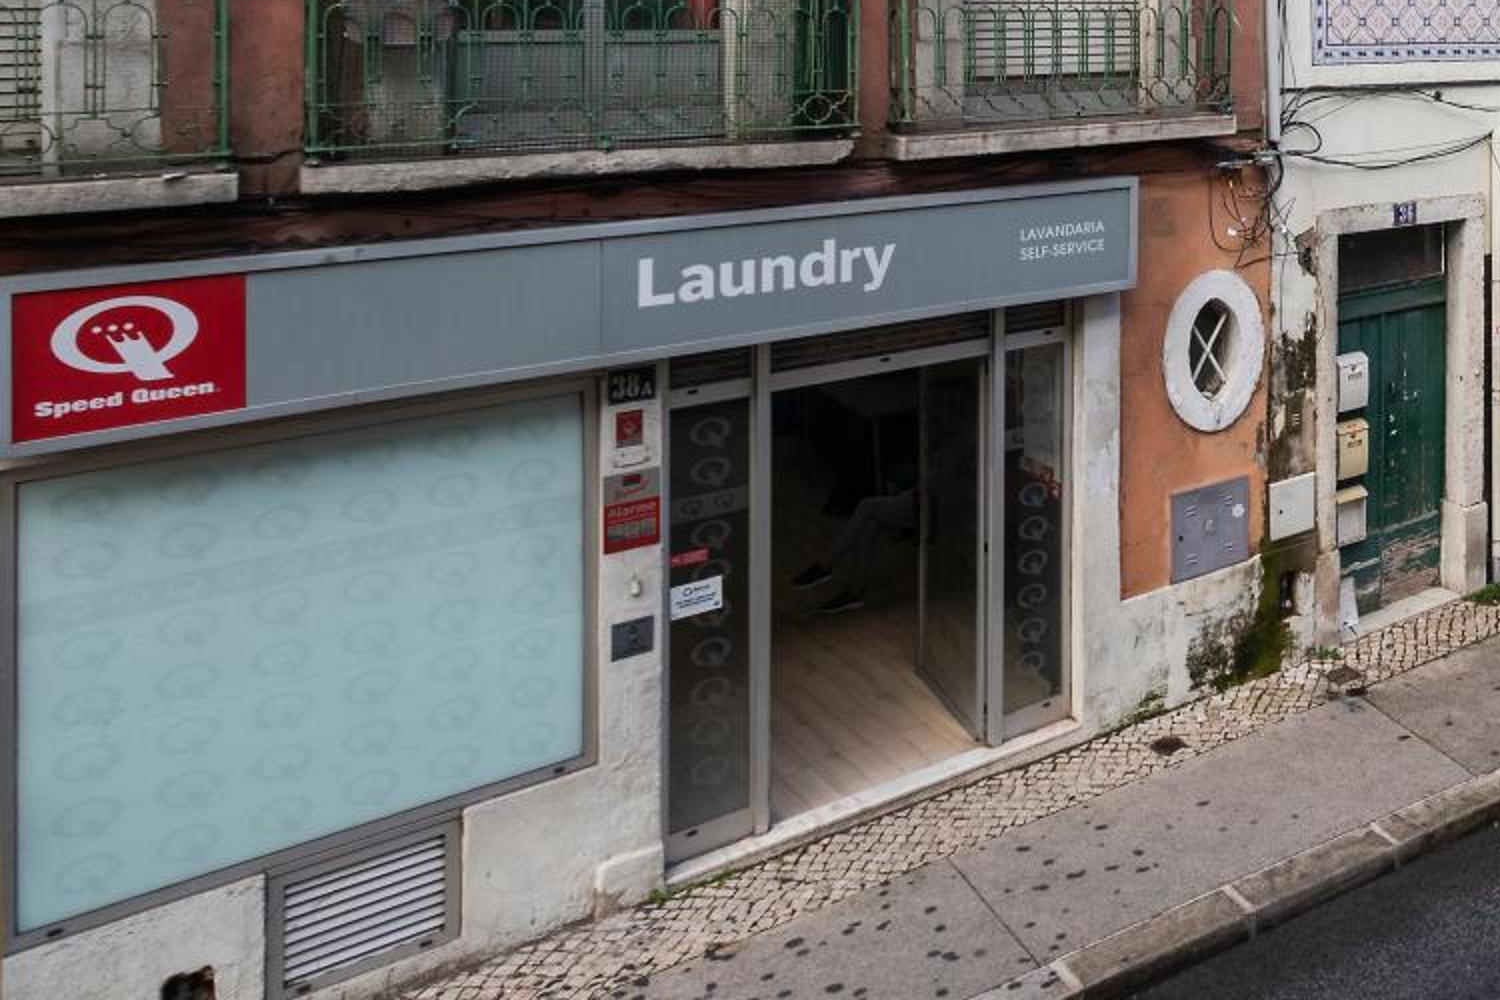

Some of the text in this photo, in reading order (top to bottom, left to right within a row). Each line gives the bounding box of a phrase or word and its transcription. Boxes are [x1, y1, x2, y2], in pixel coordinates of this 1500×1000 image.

[1020, 220, 1104, 241] LAVANDARIA
[1020, 238, 1104, 260] SELF-SERVICE
[638, 239, 897, 308] Laundry
[34, 382, 215, 418] Speed Queen
